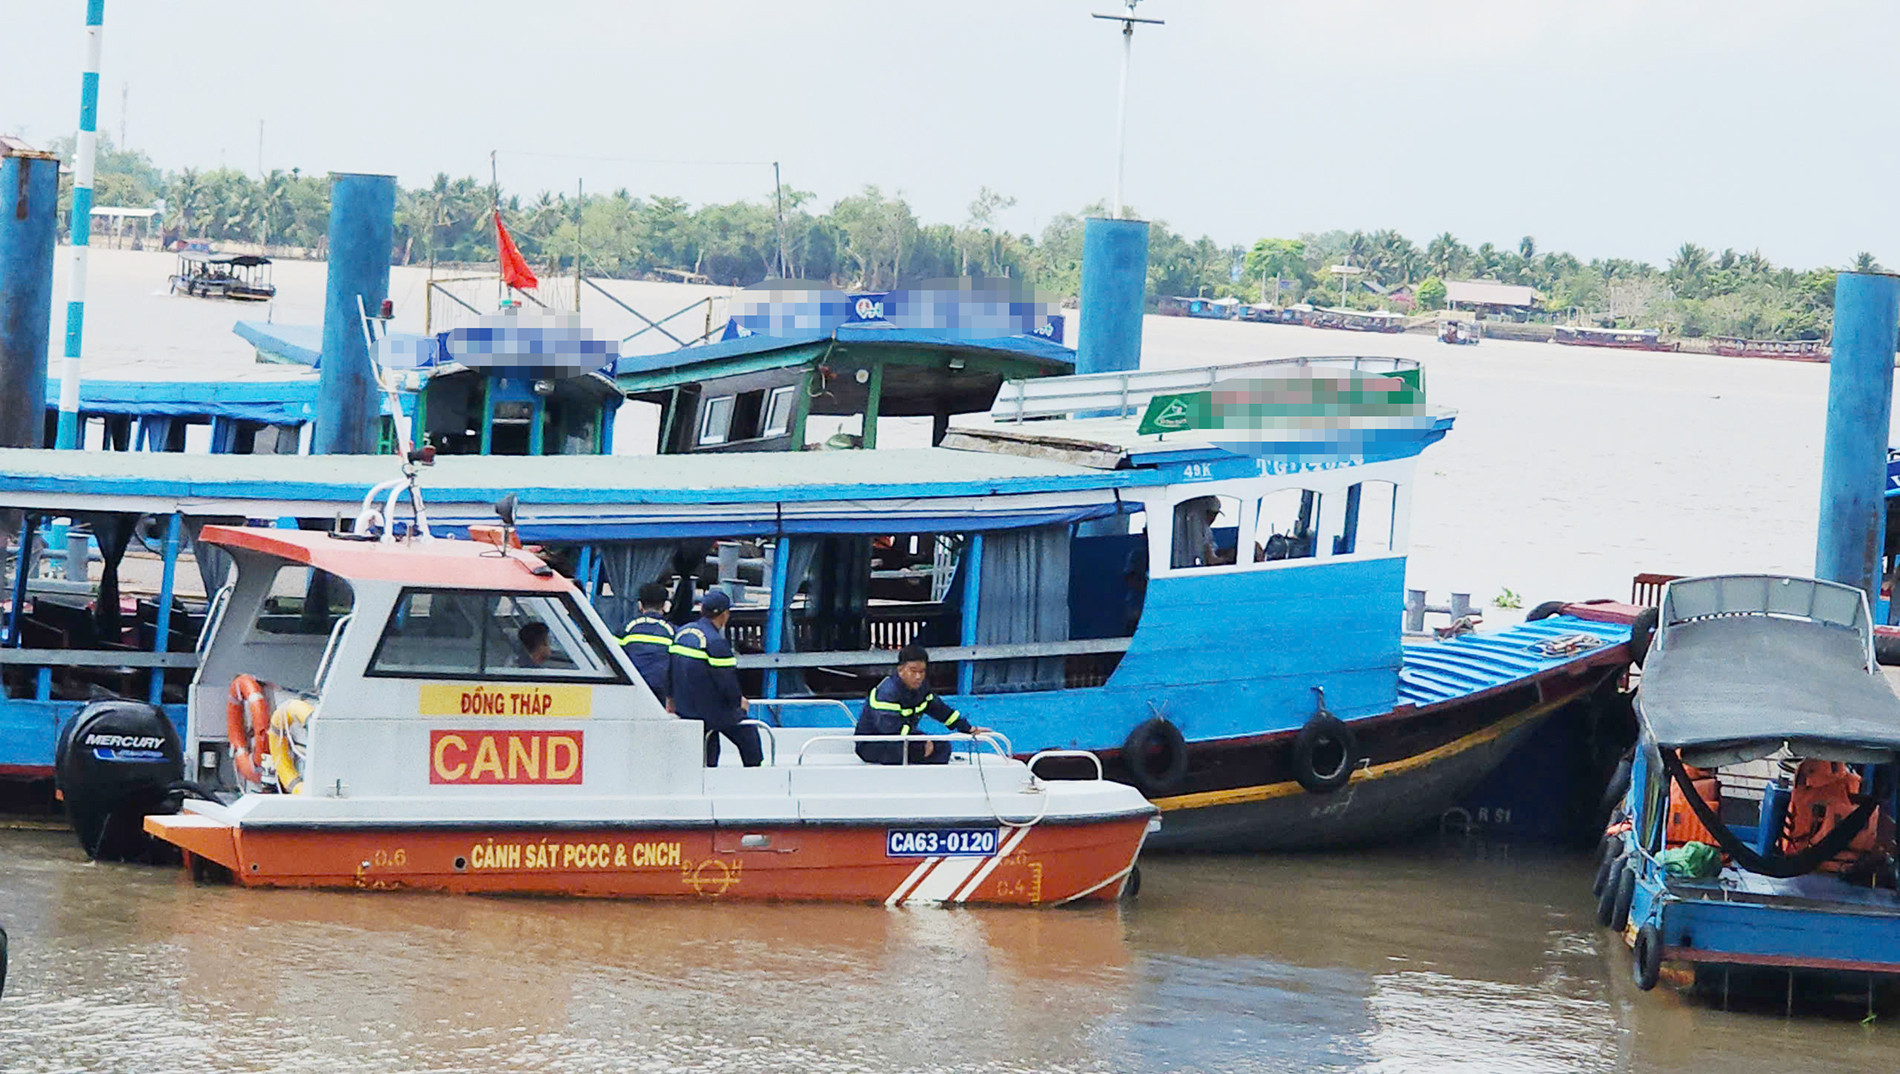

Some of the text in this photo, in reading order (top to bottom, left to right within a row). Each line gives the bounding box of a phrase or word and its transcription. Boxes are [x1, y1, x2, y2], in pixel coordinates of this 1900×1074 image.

[1184, 463, 1212, 478] 49K
[461, 686, 553, 715] ĐỒNG THÁP
[85, 733, 166, 749] MERCURY
[433, 734, 580, 781] CAND
[471, 838, 681, 868] CẢNH SÁT PCCC & CNCH
[890, 831, 995, 852] CA63-0120
